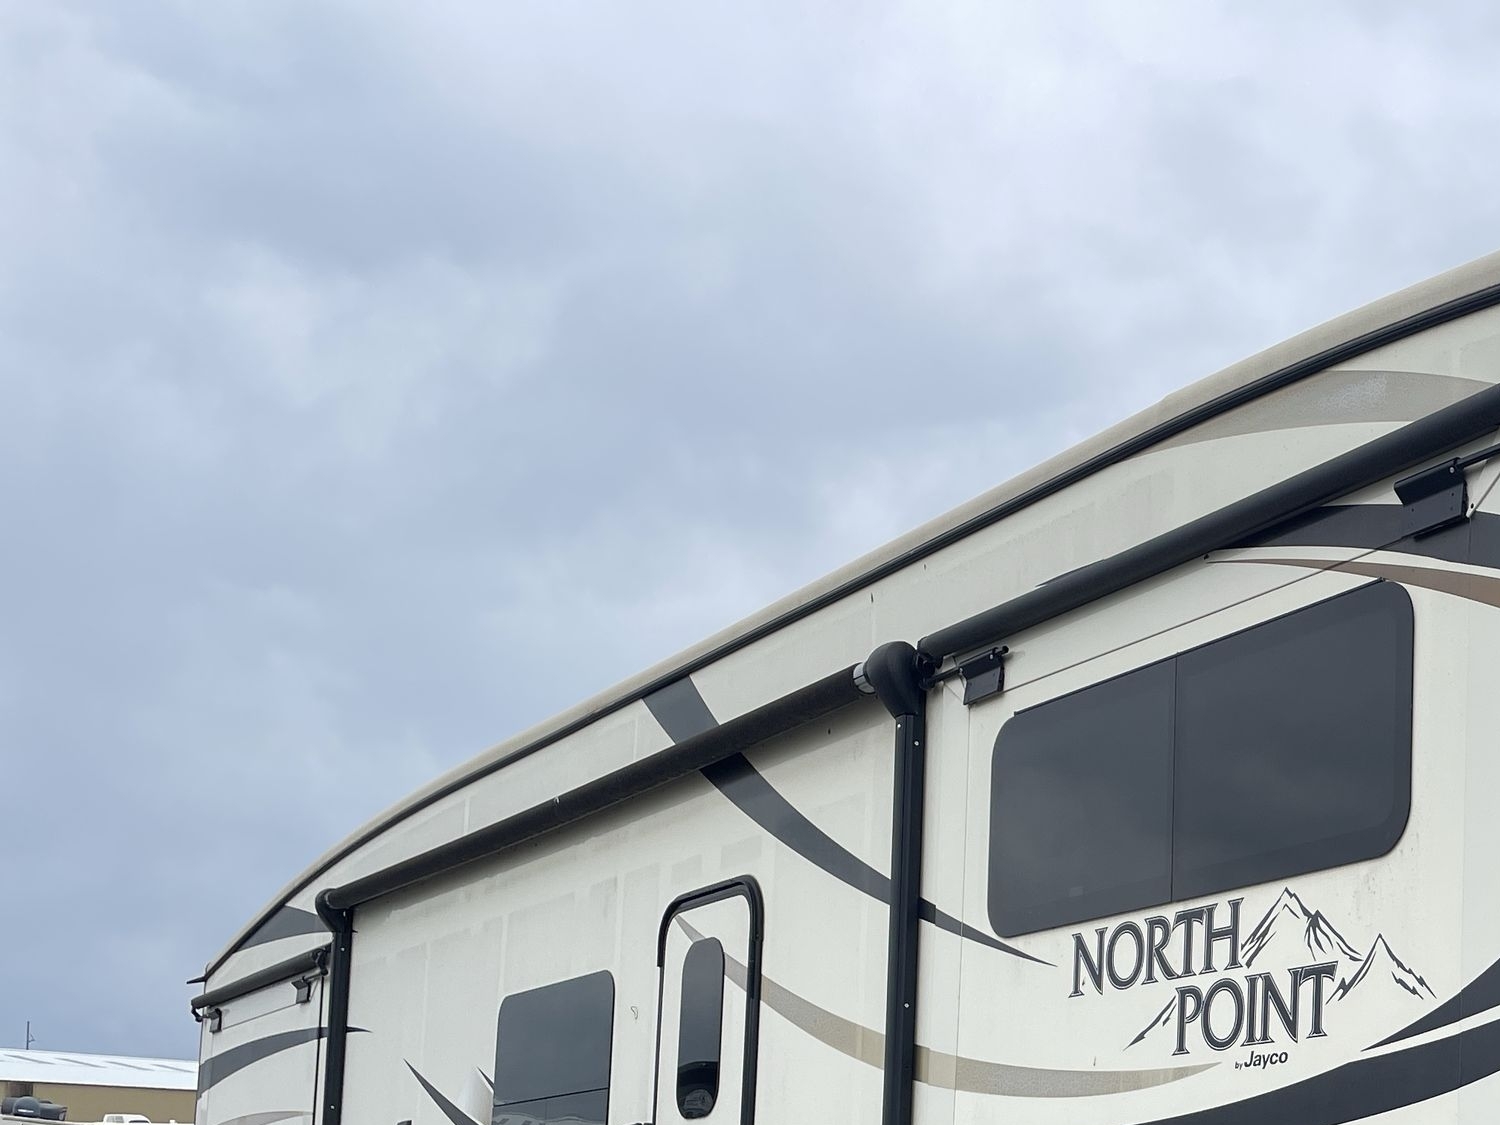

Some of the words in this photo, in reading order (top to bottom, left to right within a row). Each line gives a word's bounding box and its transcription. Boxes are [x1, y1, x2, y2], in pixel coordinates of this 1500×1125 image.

[1068, 897, 1244, 998] NORTH
[1172, 960, 1339, 1056] POINT
[1234, 1060, 1243, 1070] by
[1243, 1050, 1289, 1070] Jayco
